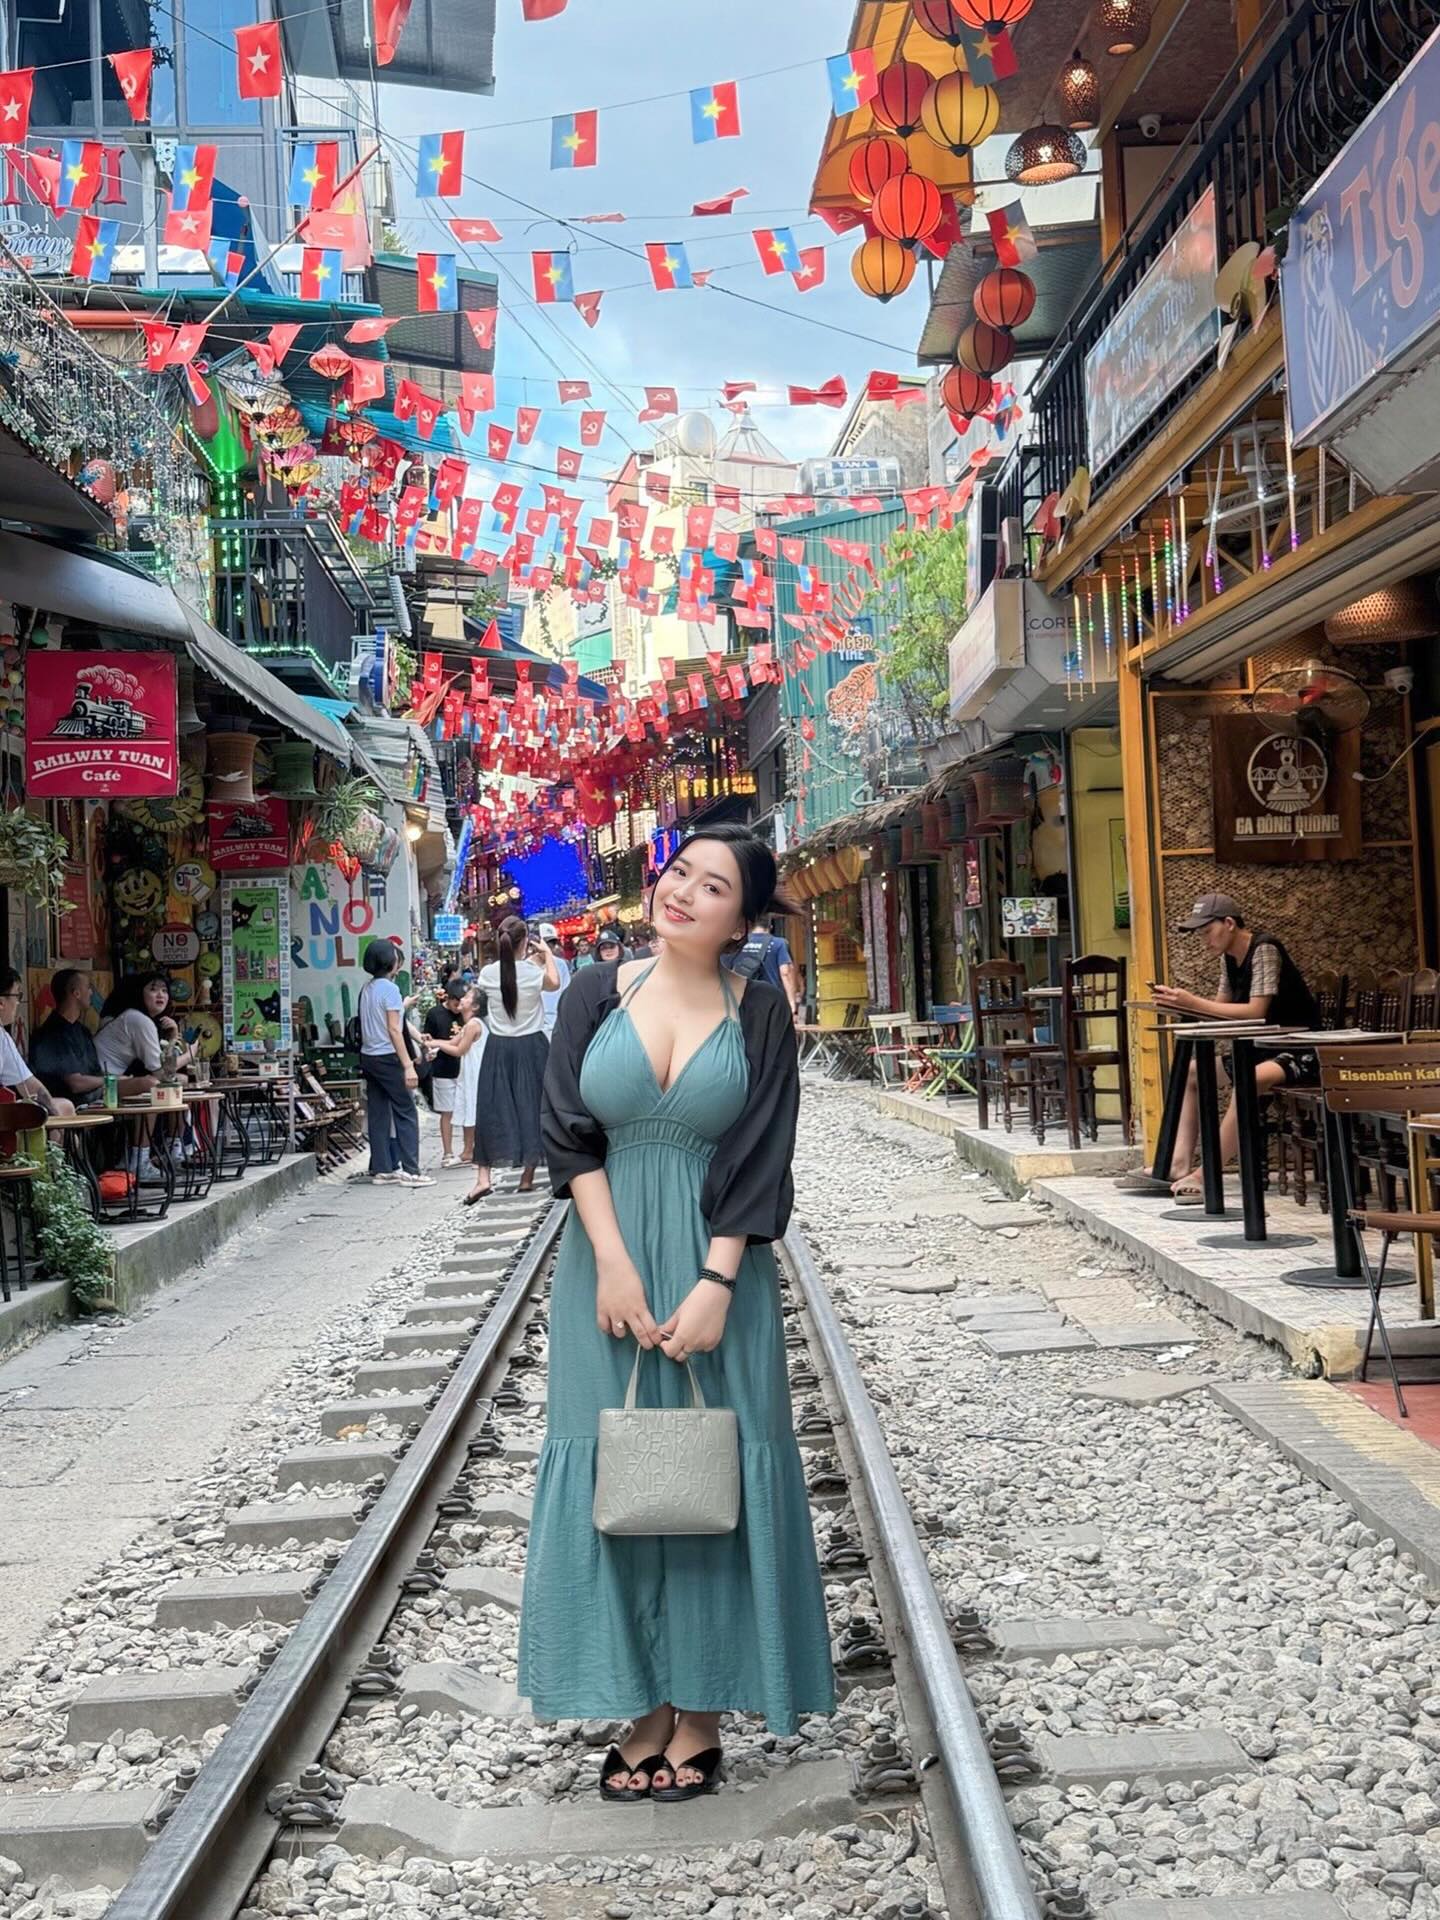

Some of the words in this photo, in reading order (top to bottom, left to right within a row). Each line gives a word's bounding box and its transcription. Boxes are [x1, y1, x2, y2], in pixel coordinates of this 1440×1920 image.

[839, 649, 865, 661] TIME
[33, 750, 114, 772] RAILWAY
[119, 750, 165, 769] TUAN
[82, 770, 121, 781] Café
[1235, 817, 1254, 835] GA
[213, 842, 256, 857] RAILWAY
[258, 843, 284, 853] TUAN
[309, 899, 374, 936] NO
[163, 933, 188, 947] NO
